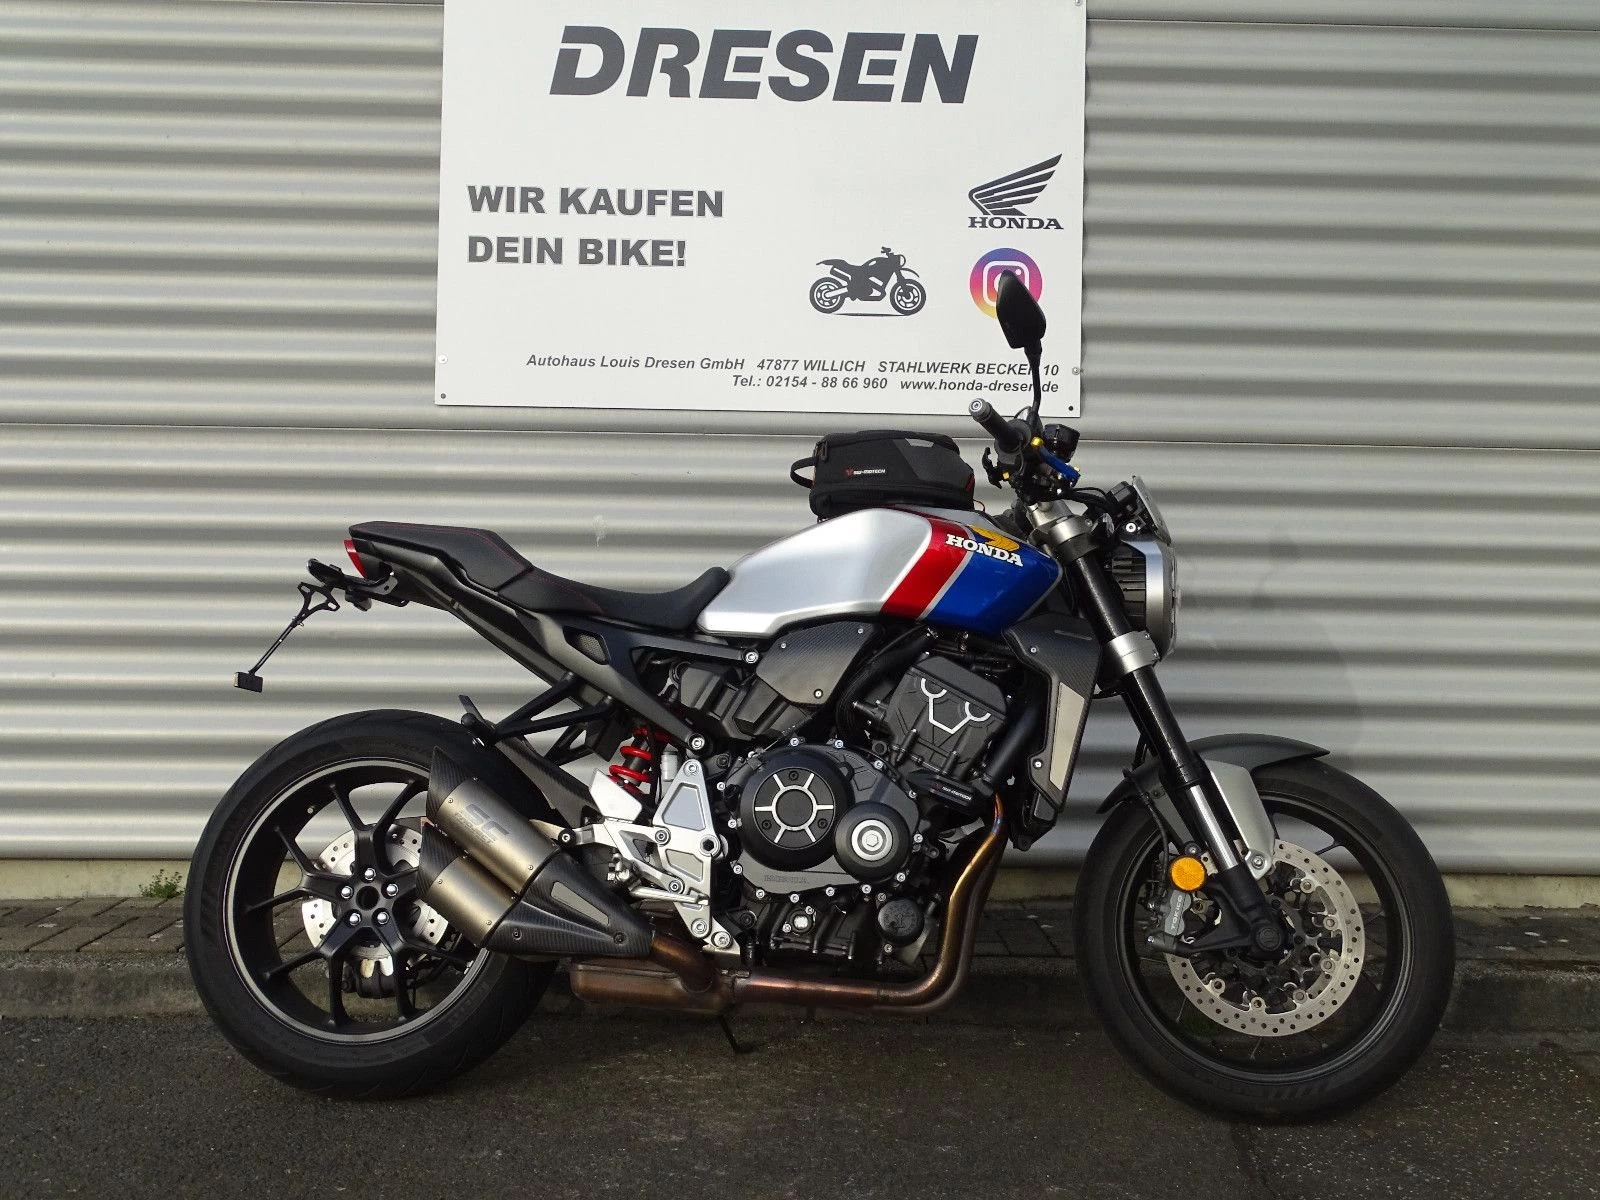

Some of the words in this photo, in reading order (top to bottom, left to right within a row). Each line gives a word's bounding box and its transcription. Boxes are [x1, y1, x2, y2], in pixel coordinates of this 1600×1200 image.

[550, 25, 979, 104] DRESEN
[467, 185, 546, 214] WIR
[559, 187, 723, 218] KAUFEN
[968, 216, 1064, 230] HONDA
[468, 235, 563, 265] DEIN
[578, 238, 686, 267] BIKE!
[526, 355, 596, 368] Autohaus
[600, 355, 640, 368] Louis
[644, 356, 695, 369] Dresen
[700, 357, 745, 370] GmbH
[756, 359, 799, 371] 47877
[803, 359, 866, 372] WILLICH
[878, 360, 972, 375] STAHLWERK
[1043, 364, 1060, 376] 10
[732, 374, 762, 387] Tel.:
[766, 375, 808, 388] 02154
[821, 376, 838, 389] 88
[842, 377, 859, 389] 66
[863, 377, 888, 390] 960
[945, 533, 1024, 567] HONDA
[1170, 895, 1183, 930] TOKICO
